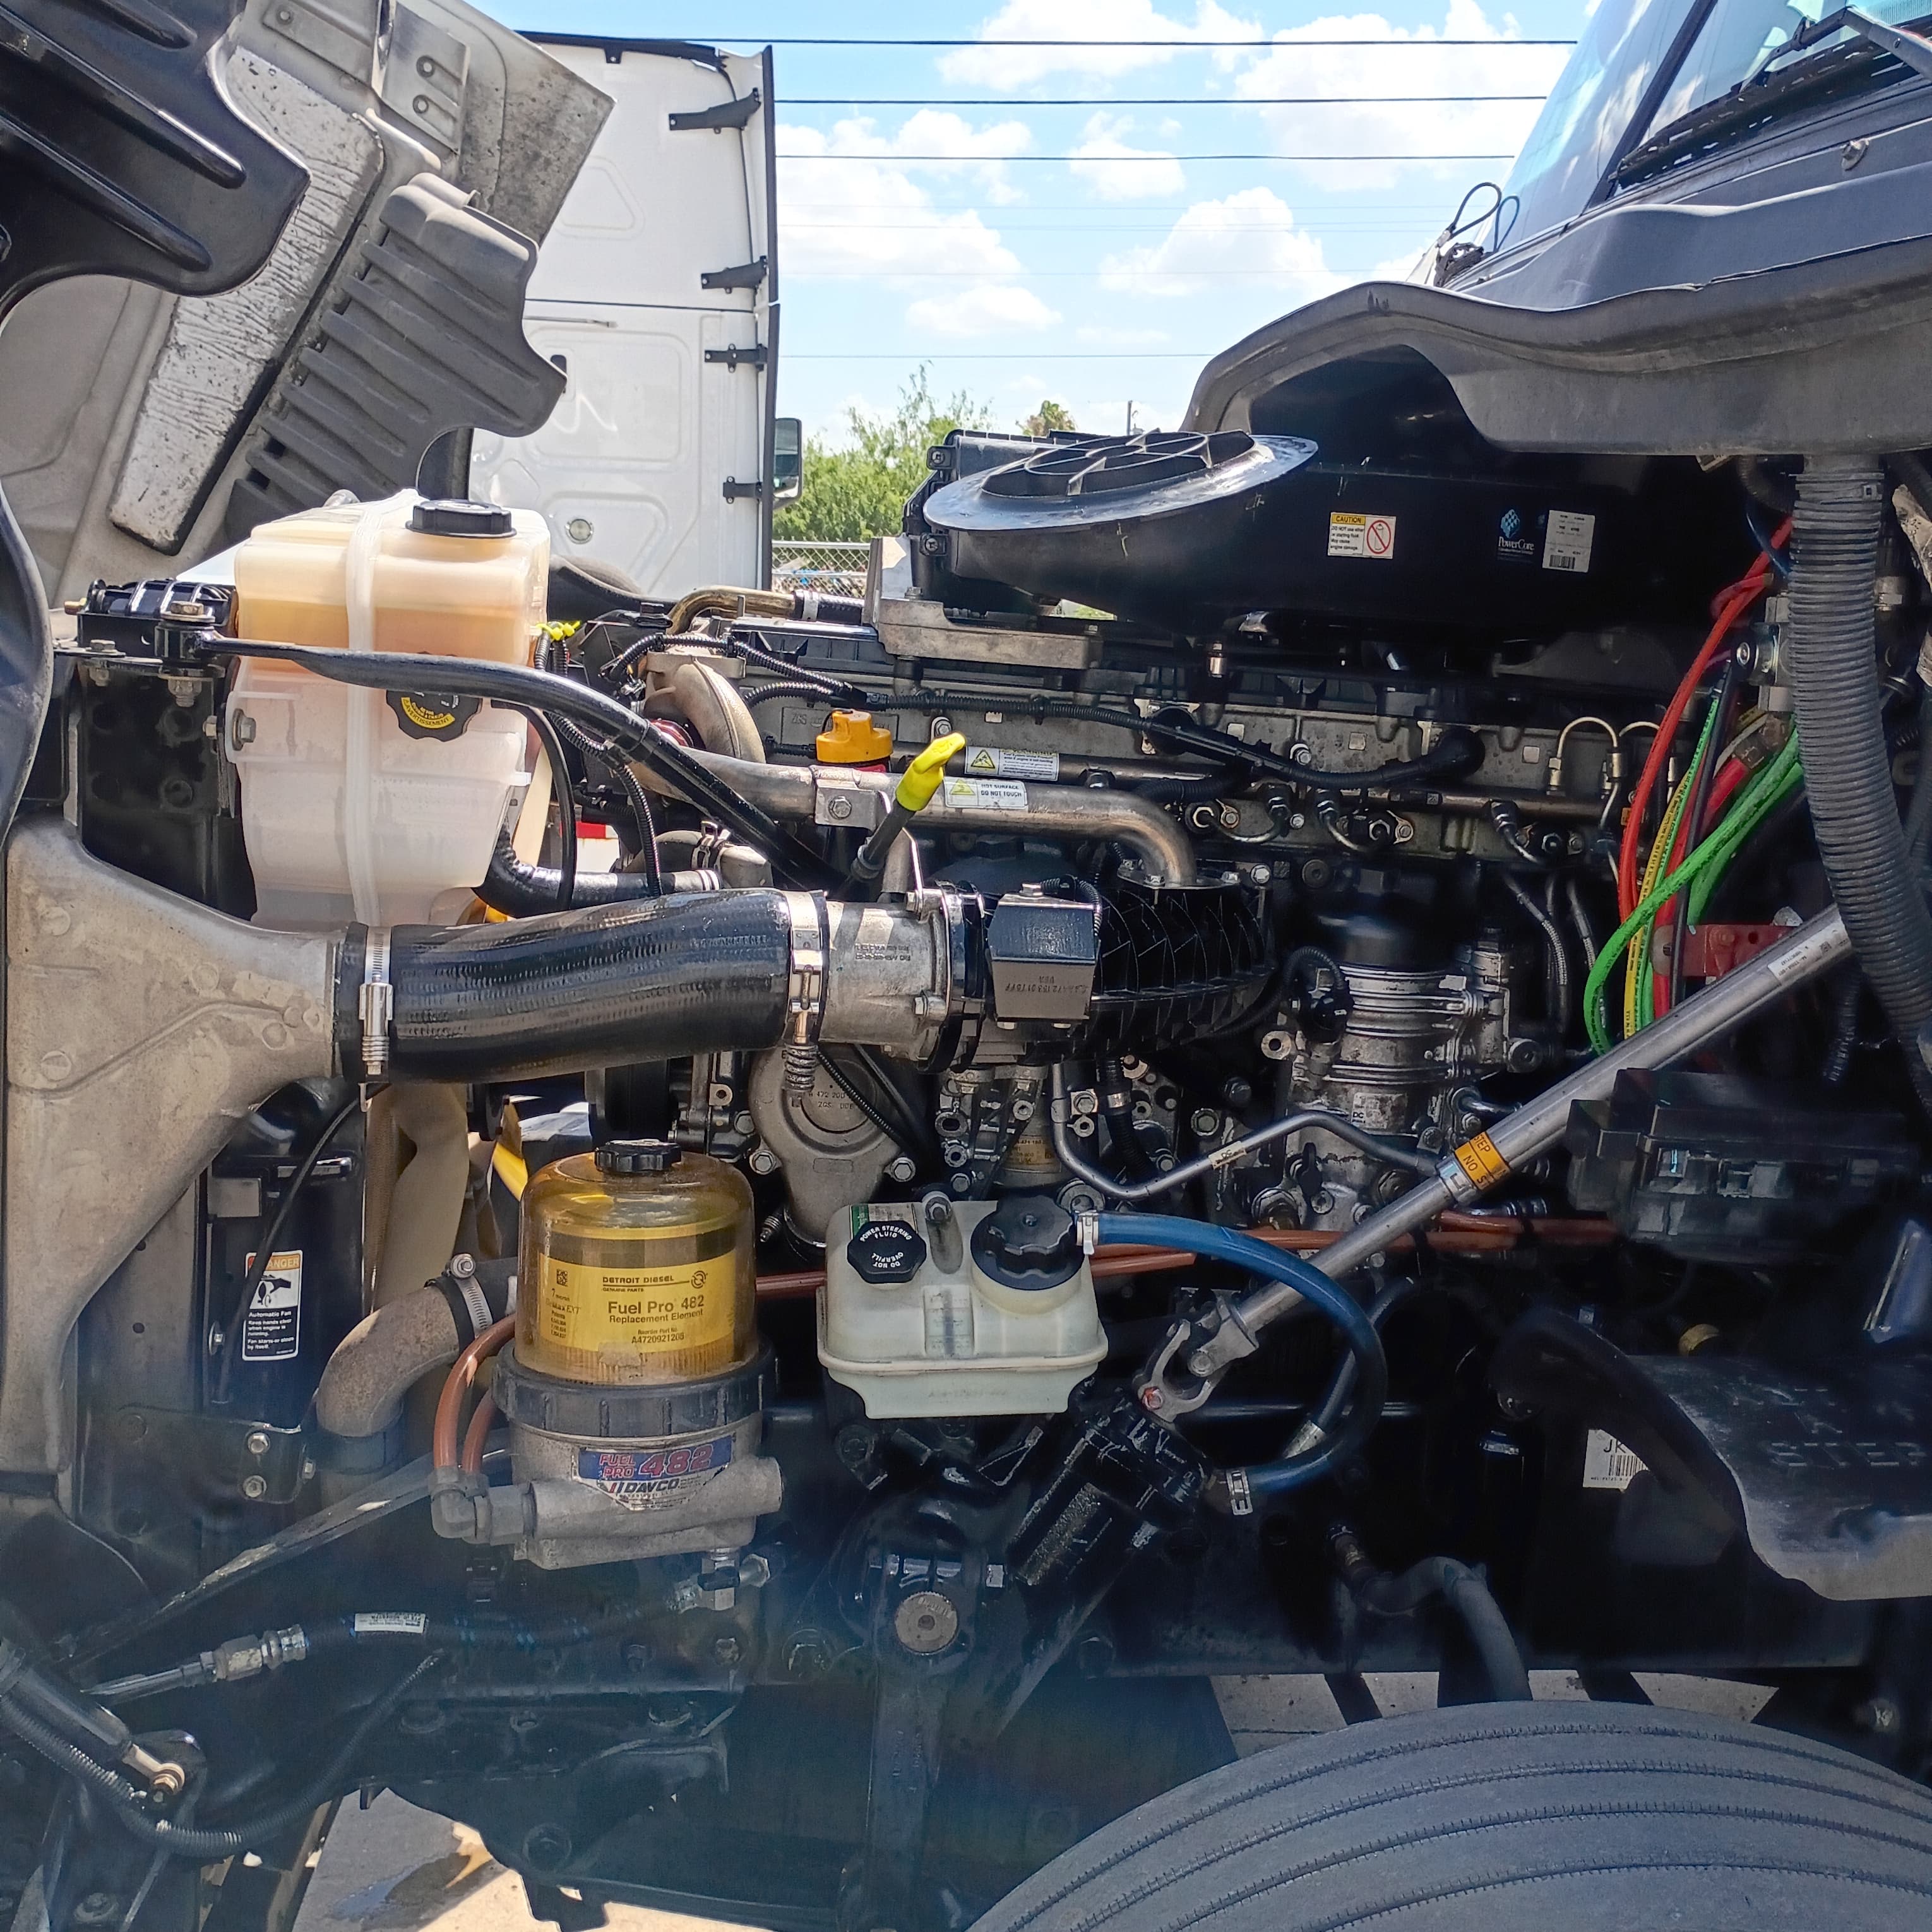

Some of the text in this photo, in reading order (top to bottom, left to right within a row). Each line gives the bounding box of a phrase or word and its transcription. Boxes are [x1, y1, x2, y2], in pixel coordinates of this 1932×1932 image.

[1498, 536, 1534, 551] PowerCore
[405, 705, 449, 726] AVERTISSEMENT
[1474, 1134, 1491, 1152] STEP
[1463, 1155, 1478, 1171] NO
[860, 1225, 912, 1242] POWER STEERING
[265, 1257, 299, 1268] ANGER
[871, 1252, 903, 1263] OVERFILL
[608, 1294, 704, 1314] Fuel Pro 482
[609, 1308, 703, 1325] Replacement Element
[600, 1453, 635, 1466] FUEL
[638, 1444, 713, 1477] 482
[602, 1467, 634, 1479] PRO
[624, 1478, 680, 1493] DAVCO
